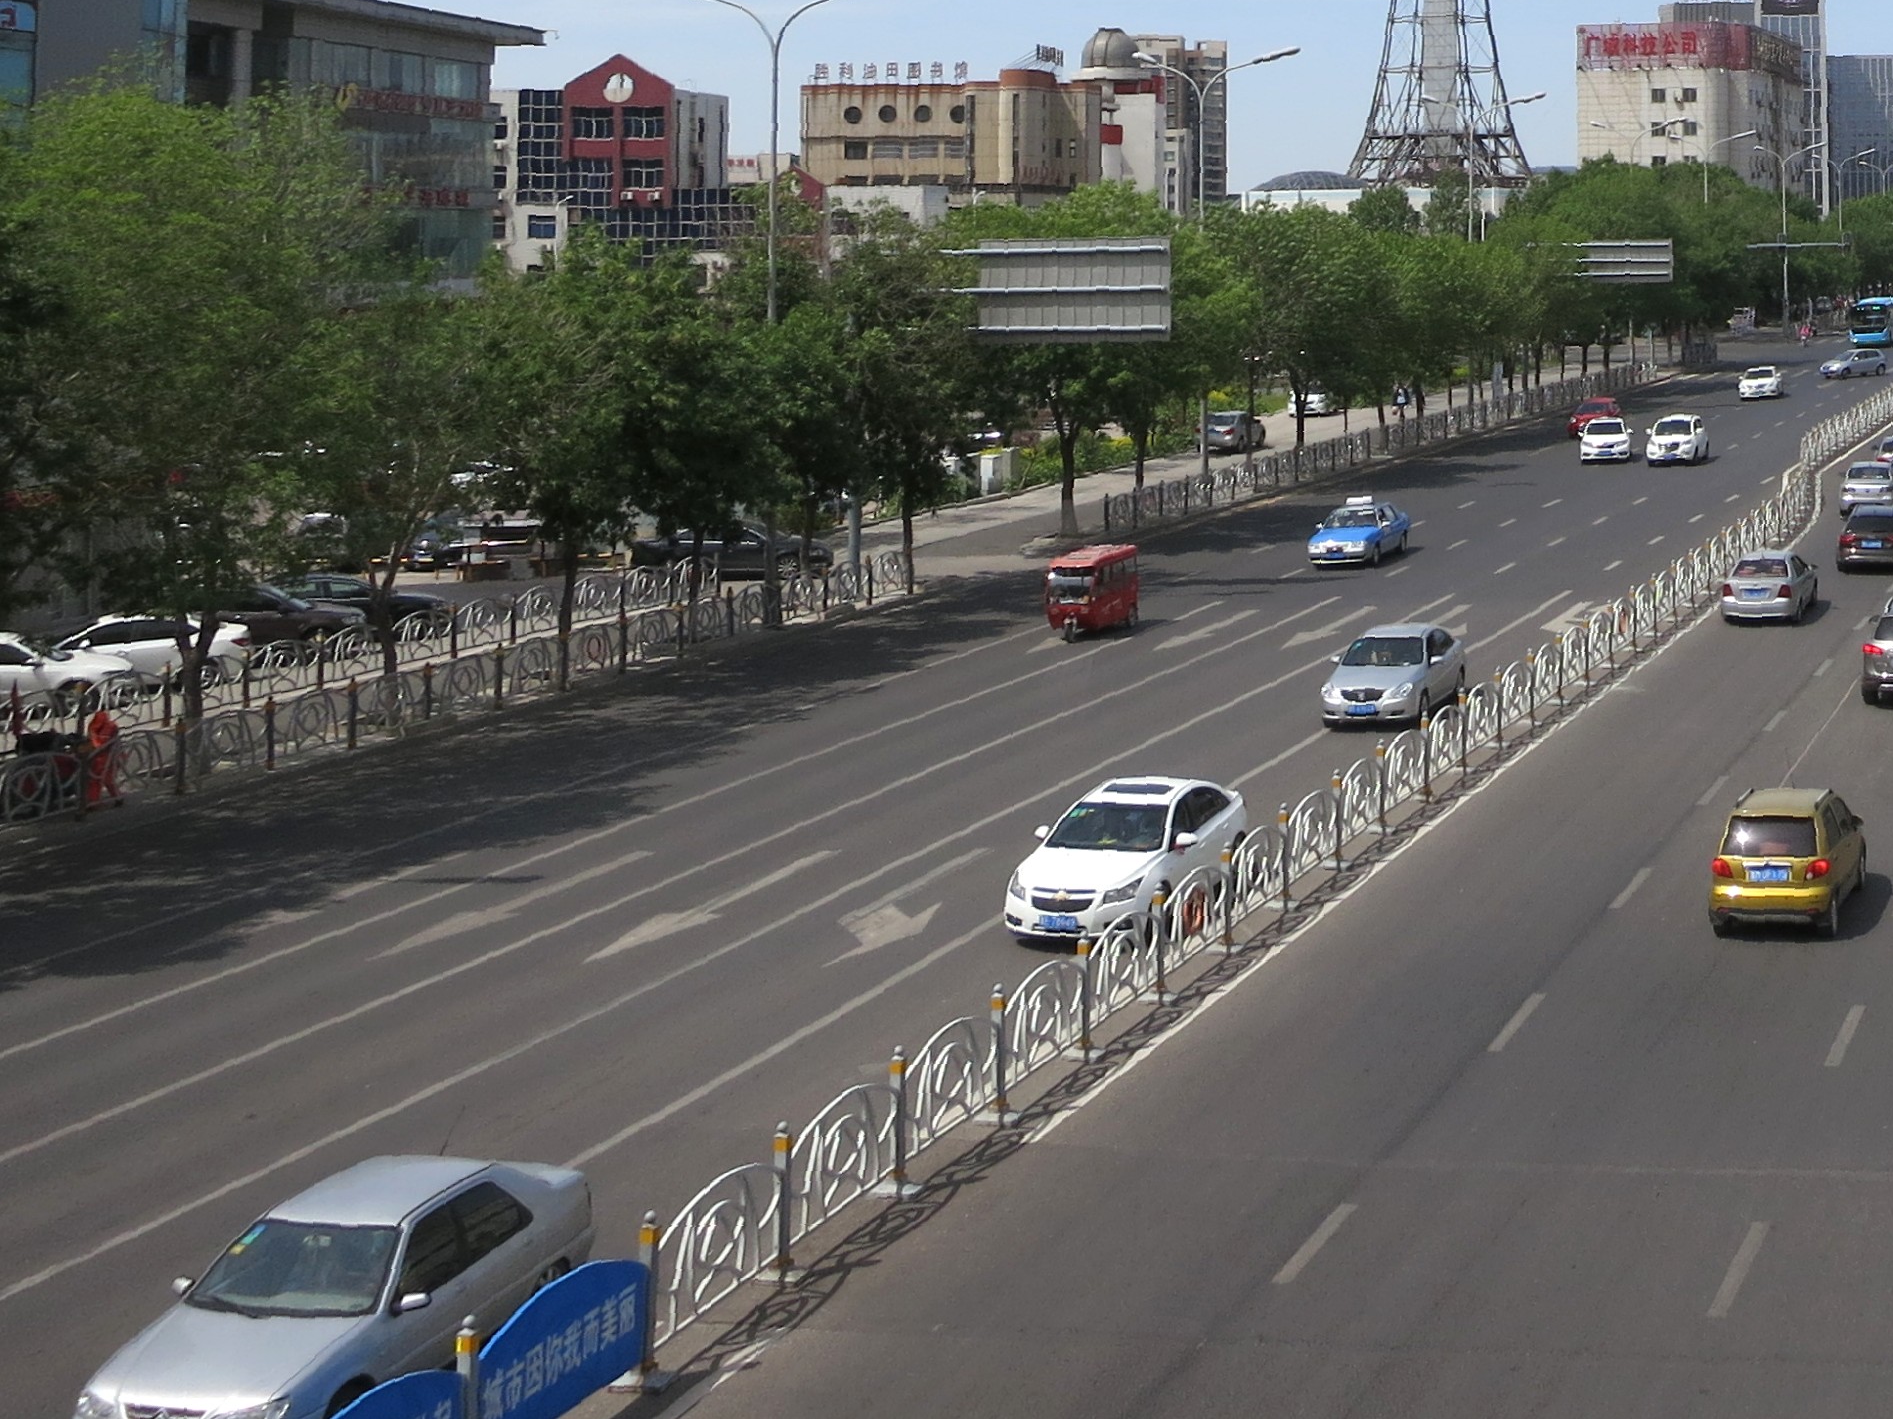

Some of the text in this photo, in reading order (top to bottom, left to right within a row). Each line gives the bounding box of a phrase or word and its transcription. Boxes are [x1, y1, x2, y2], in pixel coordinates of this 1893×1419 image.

[814, 61, 969, 80] 胜利油田图书馆
[483, 1282, 637, 1419] 城市因你我而美丽
